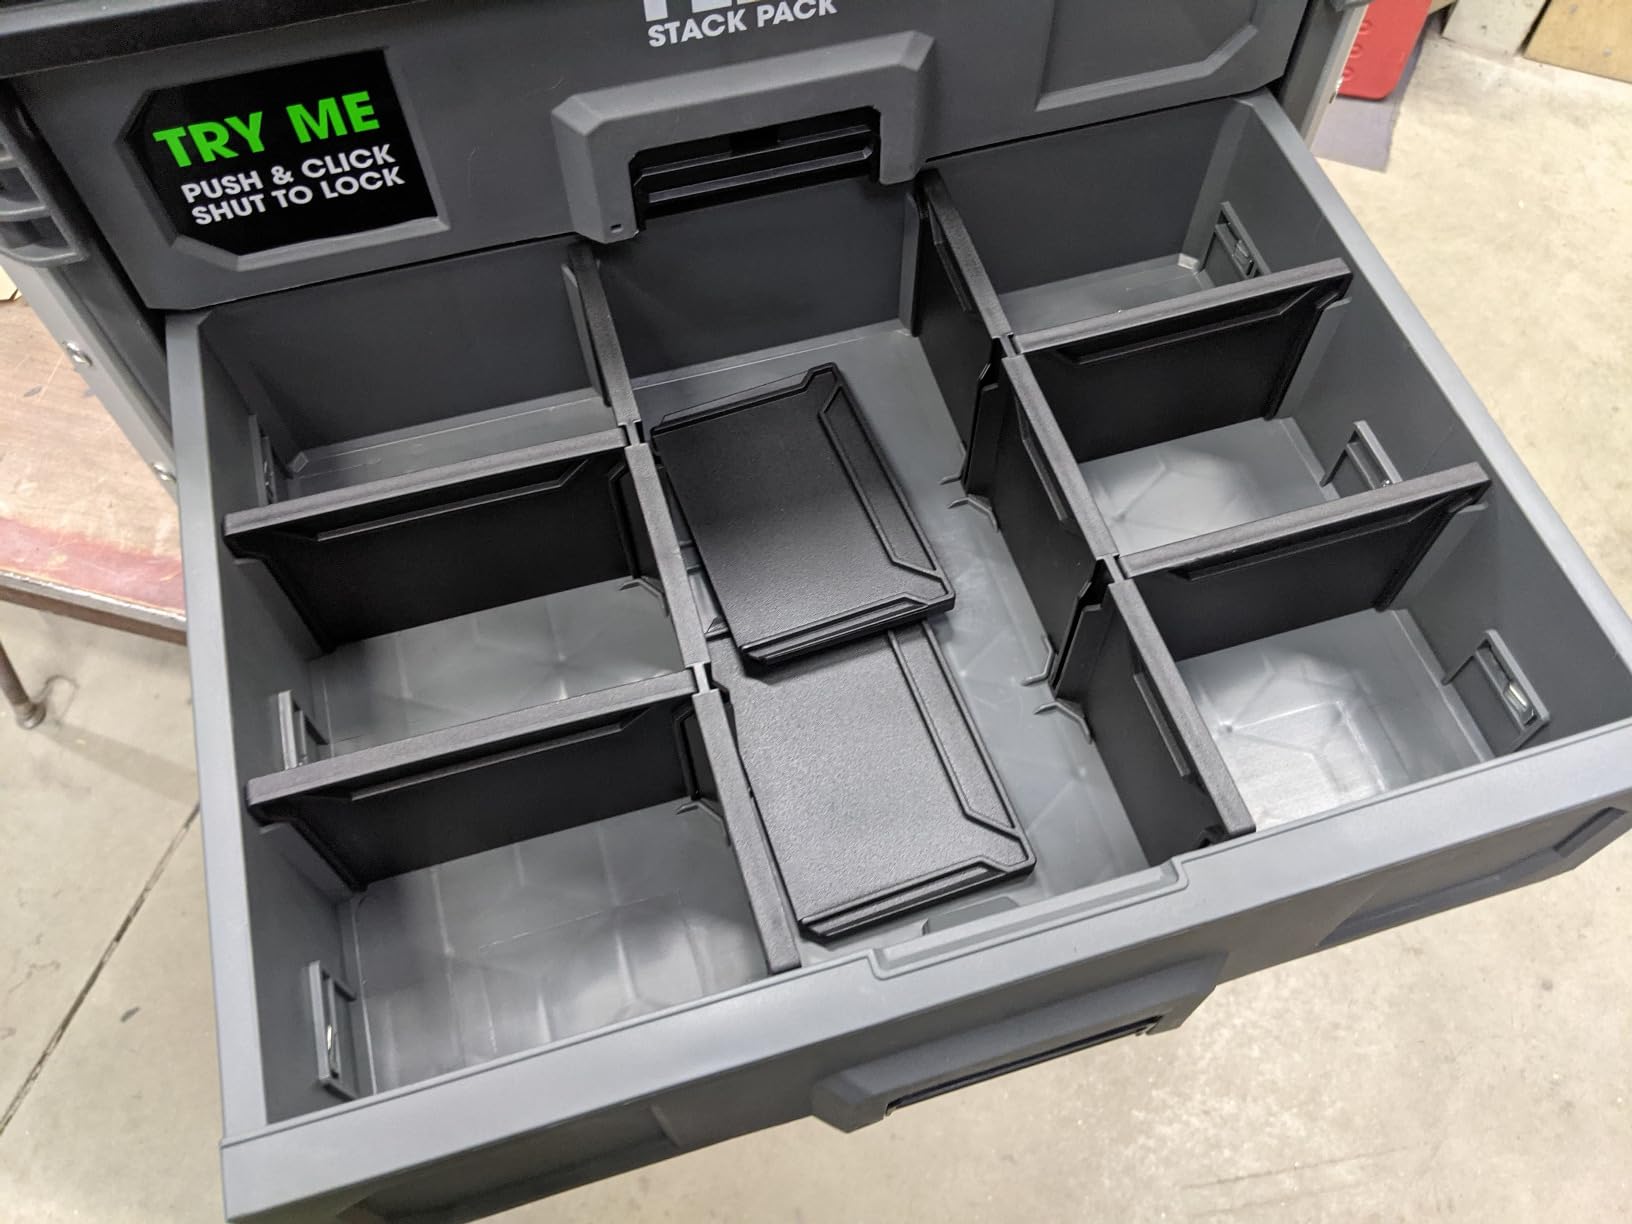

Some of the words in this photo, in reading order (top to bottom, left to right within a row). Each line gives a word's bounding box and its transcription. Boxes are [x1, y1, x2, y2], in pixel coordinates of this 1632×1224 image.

[648, 9, 747, 48] STACK
[756, 0, 838, 28] PACK
[153, 111, 265, 168] TRY
[286, 90, 380, 144] ME
[181, 170, 263, 204] PUSH
[270, 165, 295, 185] &
[301, 143, 396, 179] CLICK
[191, 193, 267, 226] SHUT
[271, 186, 313, 208] TO
[320, 166, 405, 200] LOCK
